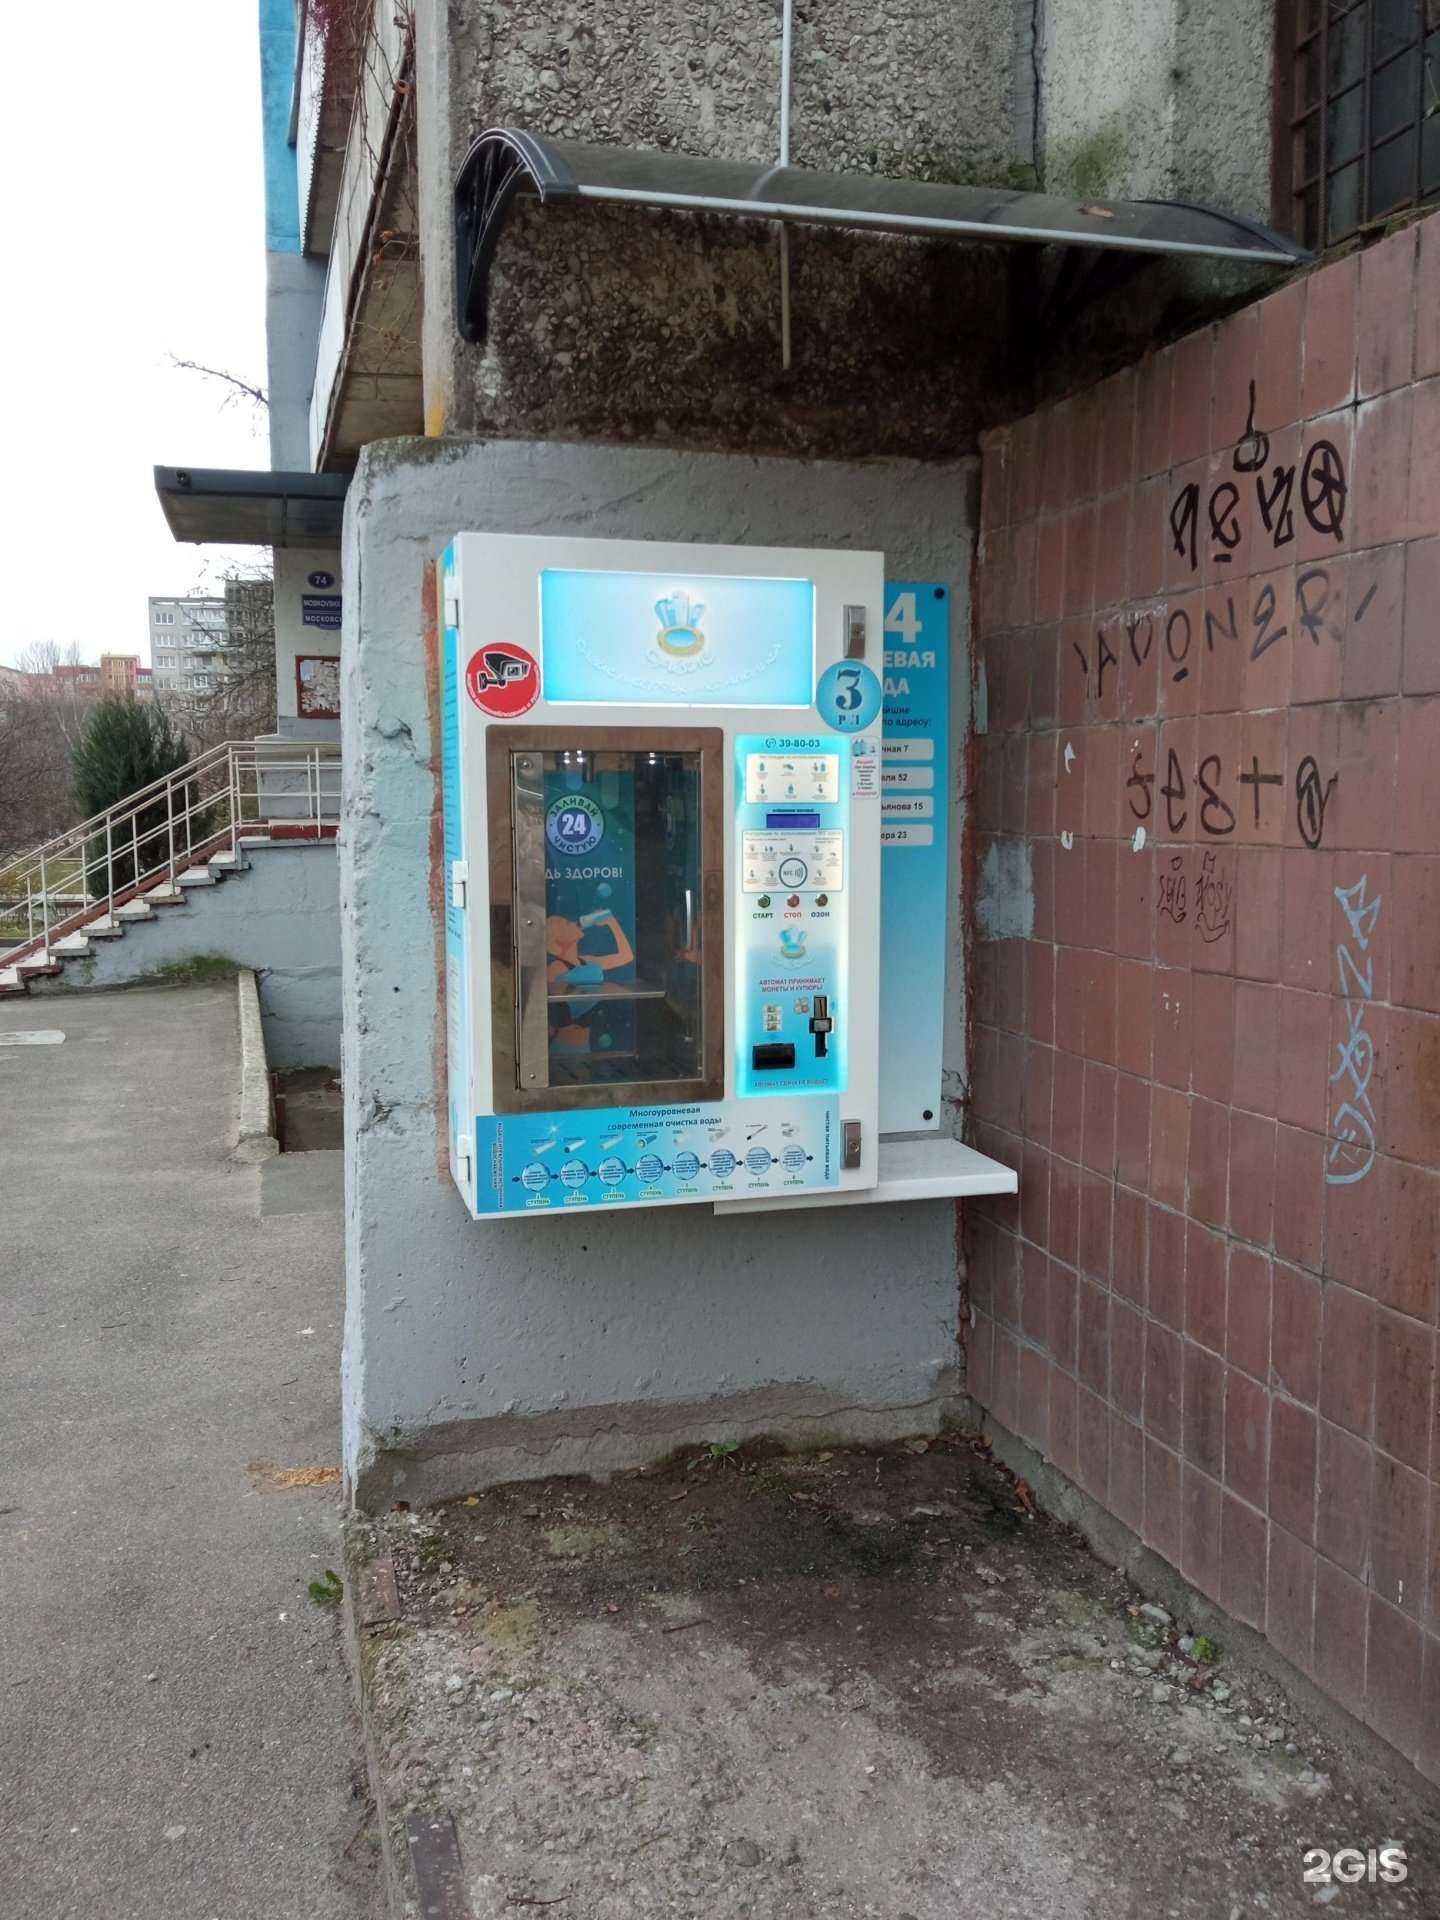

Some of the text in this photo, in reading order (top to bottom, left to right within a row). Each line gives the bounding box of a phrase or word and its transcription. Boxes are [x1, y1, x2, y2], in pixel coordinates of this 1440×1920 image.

[314, 575, 327, 585] 74
[305, 615, 342, 623] МОСКОВС
[883, 591, 923, 644] 4
[883, 650, 936, 669] ЕВАЯ
[835, 668, 864, 711] 3
[883, 677, 911, 698] ДА
[778, 739, 821, 748] 39-80-03
[881, 802, 924, 811] ьянова 15
[561, 813, 587, 836] 24
[554, 835, 597, 853] ЧИСТУЮ
[545, 867, 623, 880] ДЬ ЗДОРОВ!
[784, 911, 802, 919] СТОП
[629, 1106, 701, 1118] Многоуровневая
[607, 1117, 722, 1131] современная очистка воды
